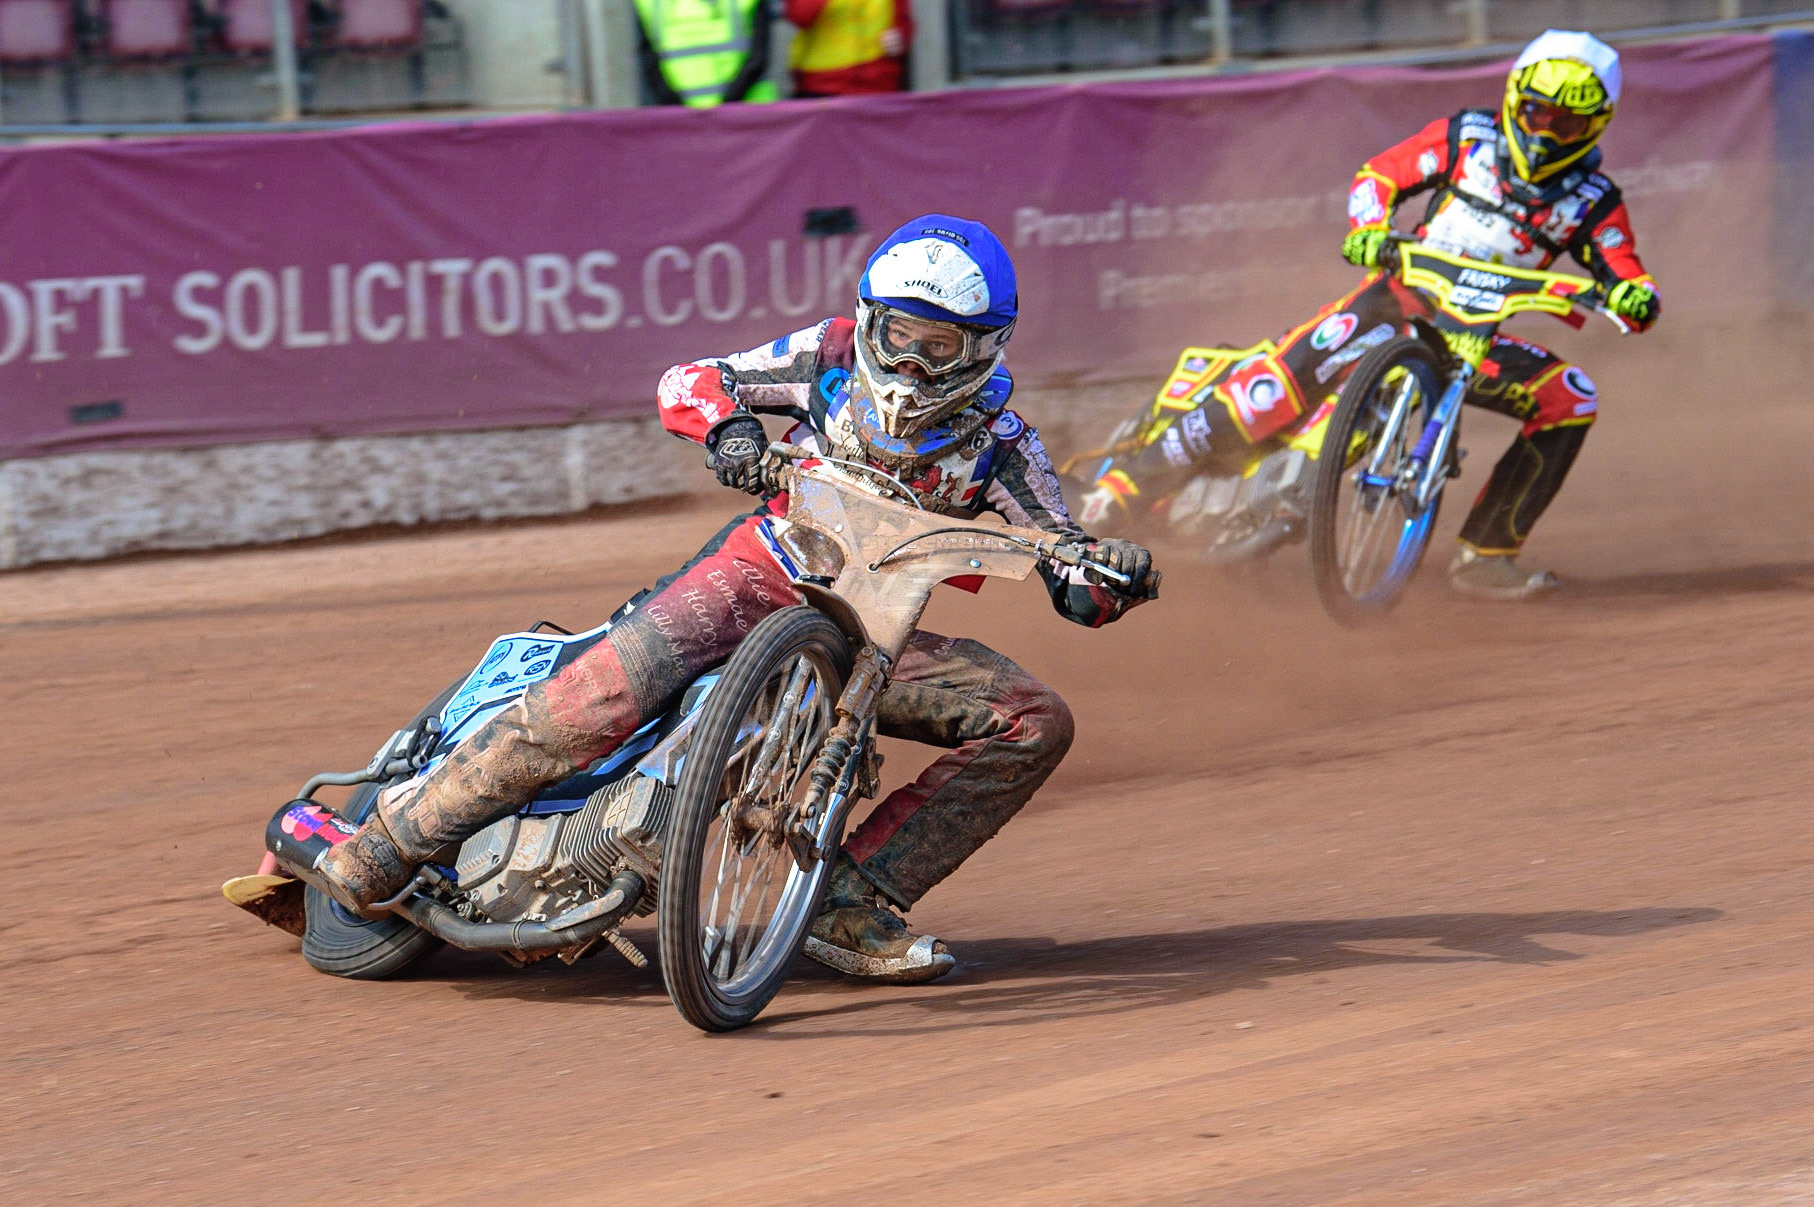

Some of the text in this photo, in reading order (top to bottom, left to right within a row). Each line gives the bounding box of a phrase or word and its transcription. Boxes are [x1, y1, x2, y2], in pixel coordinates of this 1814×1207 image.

[1014, 198, 1125, 246] Proud
[904, 280, 942, 296] SHOEI
[707, 569, 750, 633] Esmae
[732, 558, 771, 606] Ellie
[647, 604, 686, 679] Lilly-Mae
[682, 588, 718, 647] Harry
